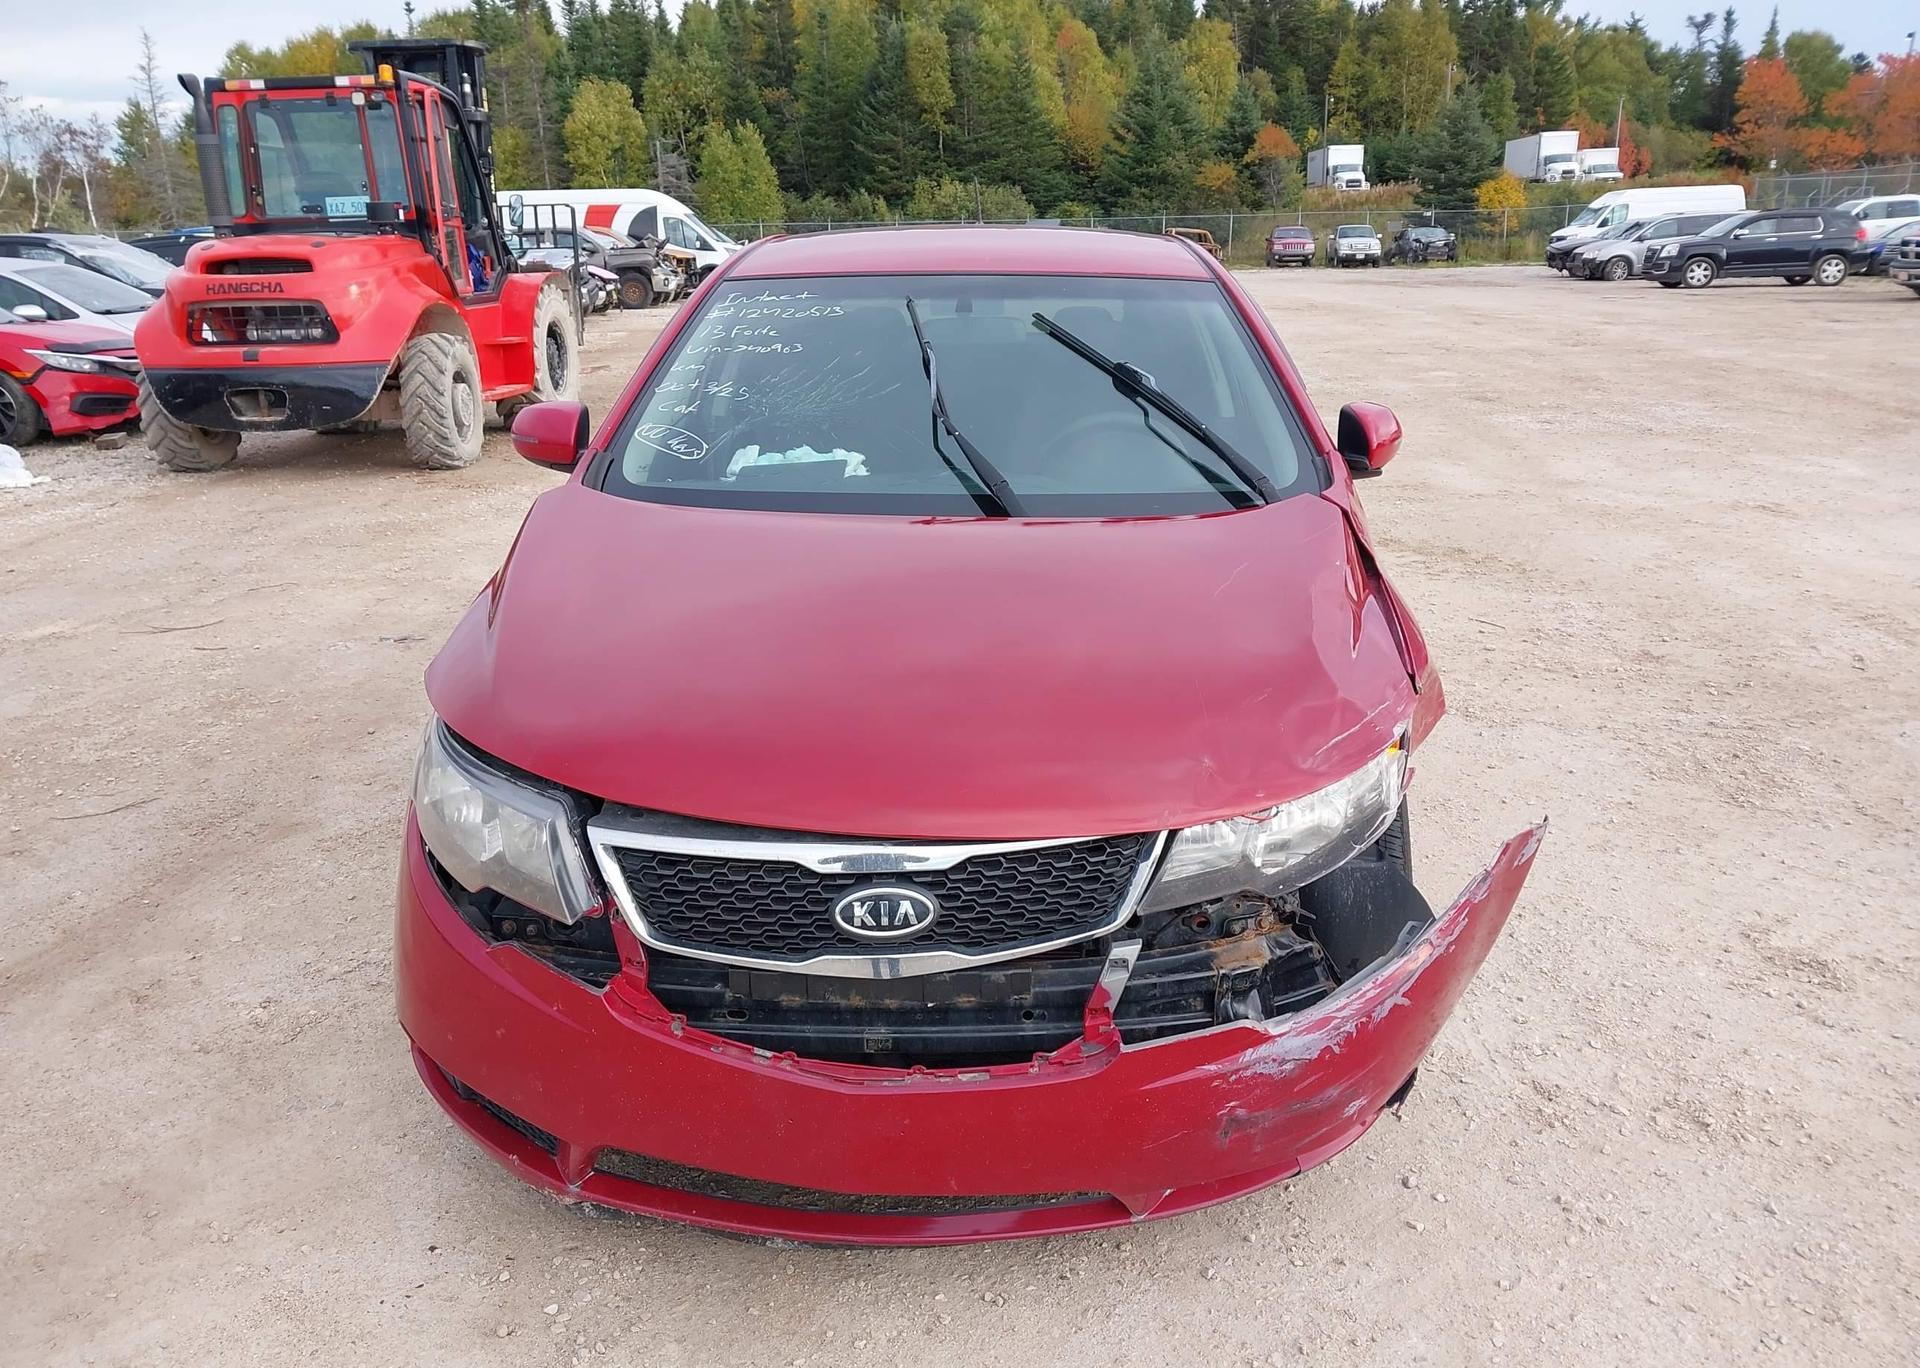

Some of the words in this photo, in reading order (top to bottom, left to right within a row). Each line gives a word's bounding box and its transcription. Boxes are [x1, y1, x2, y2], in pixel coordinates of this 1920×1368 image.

[328, 202, 346, 214] XAZ
[206, 281, 285, 296] HANGCHA
[699, 325, 726, 340] 13
[851, 900, 919, 927] KIA
